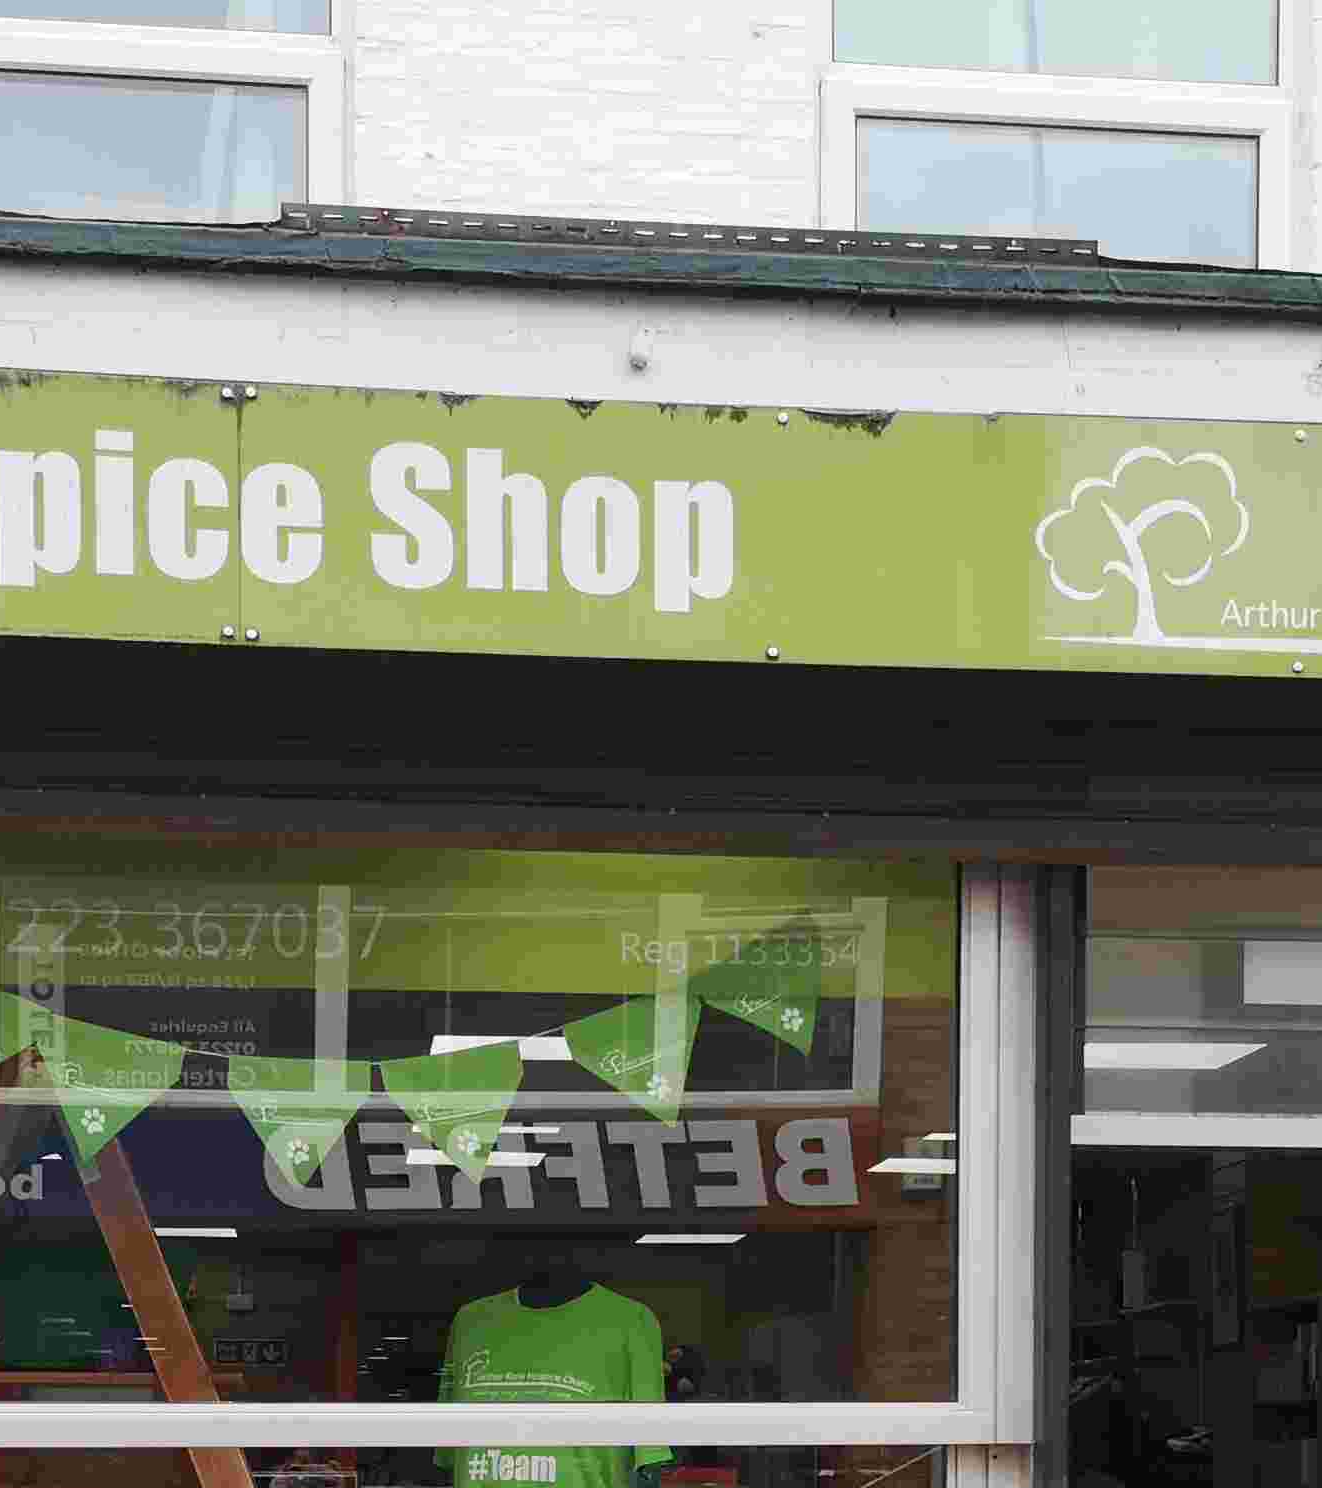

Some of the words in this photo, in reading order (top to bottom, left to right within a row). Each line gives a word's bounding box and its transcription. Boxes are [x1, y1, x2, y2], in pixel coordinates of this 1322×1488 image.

[370, 442, 734, 613] Shop
[1220, 599, 1321, 631] Arthur
[620, 931, 686, 976] Reg
[469, 1448, 558, 1482] #Team
